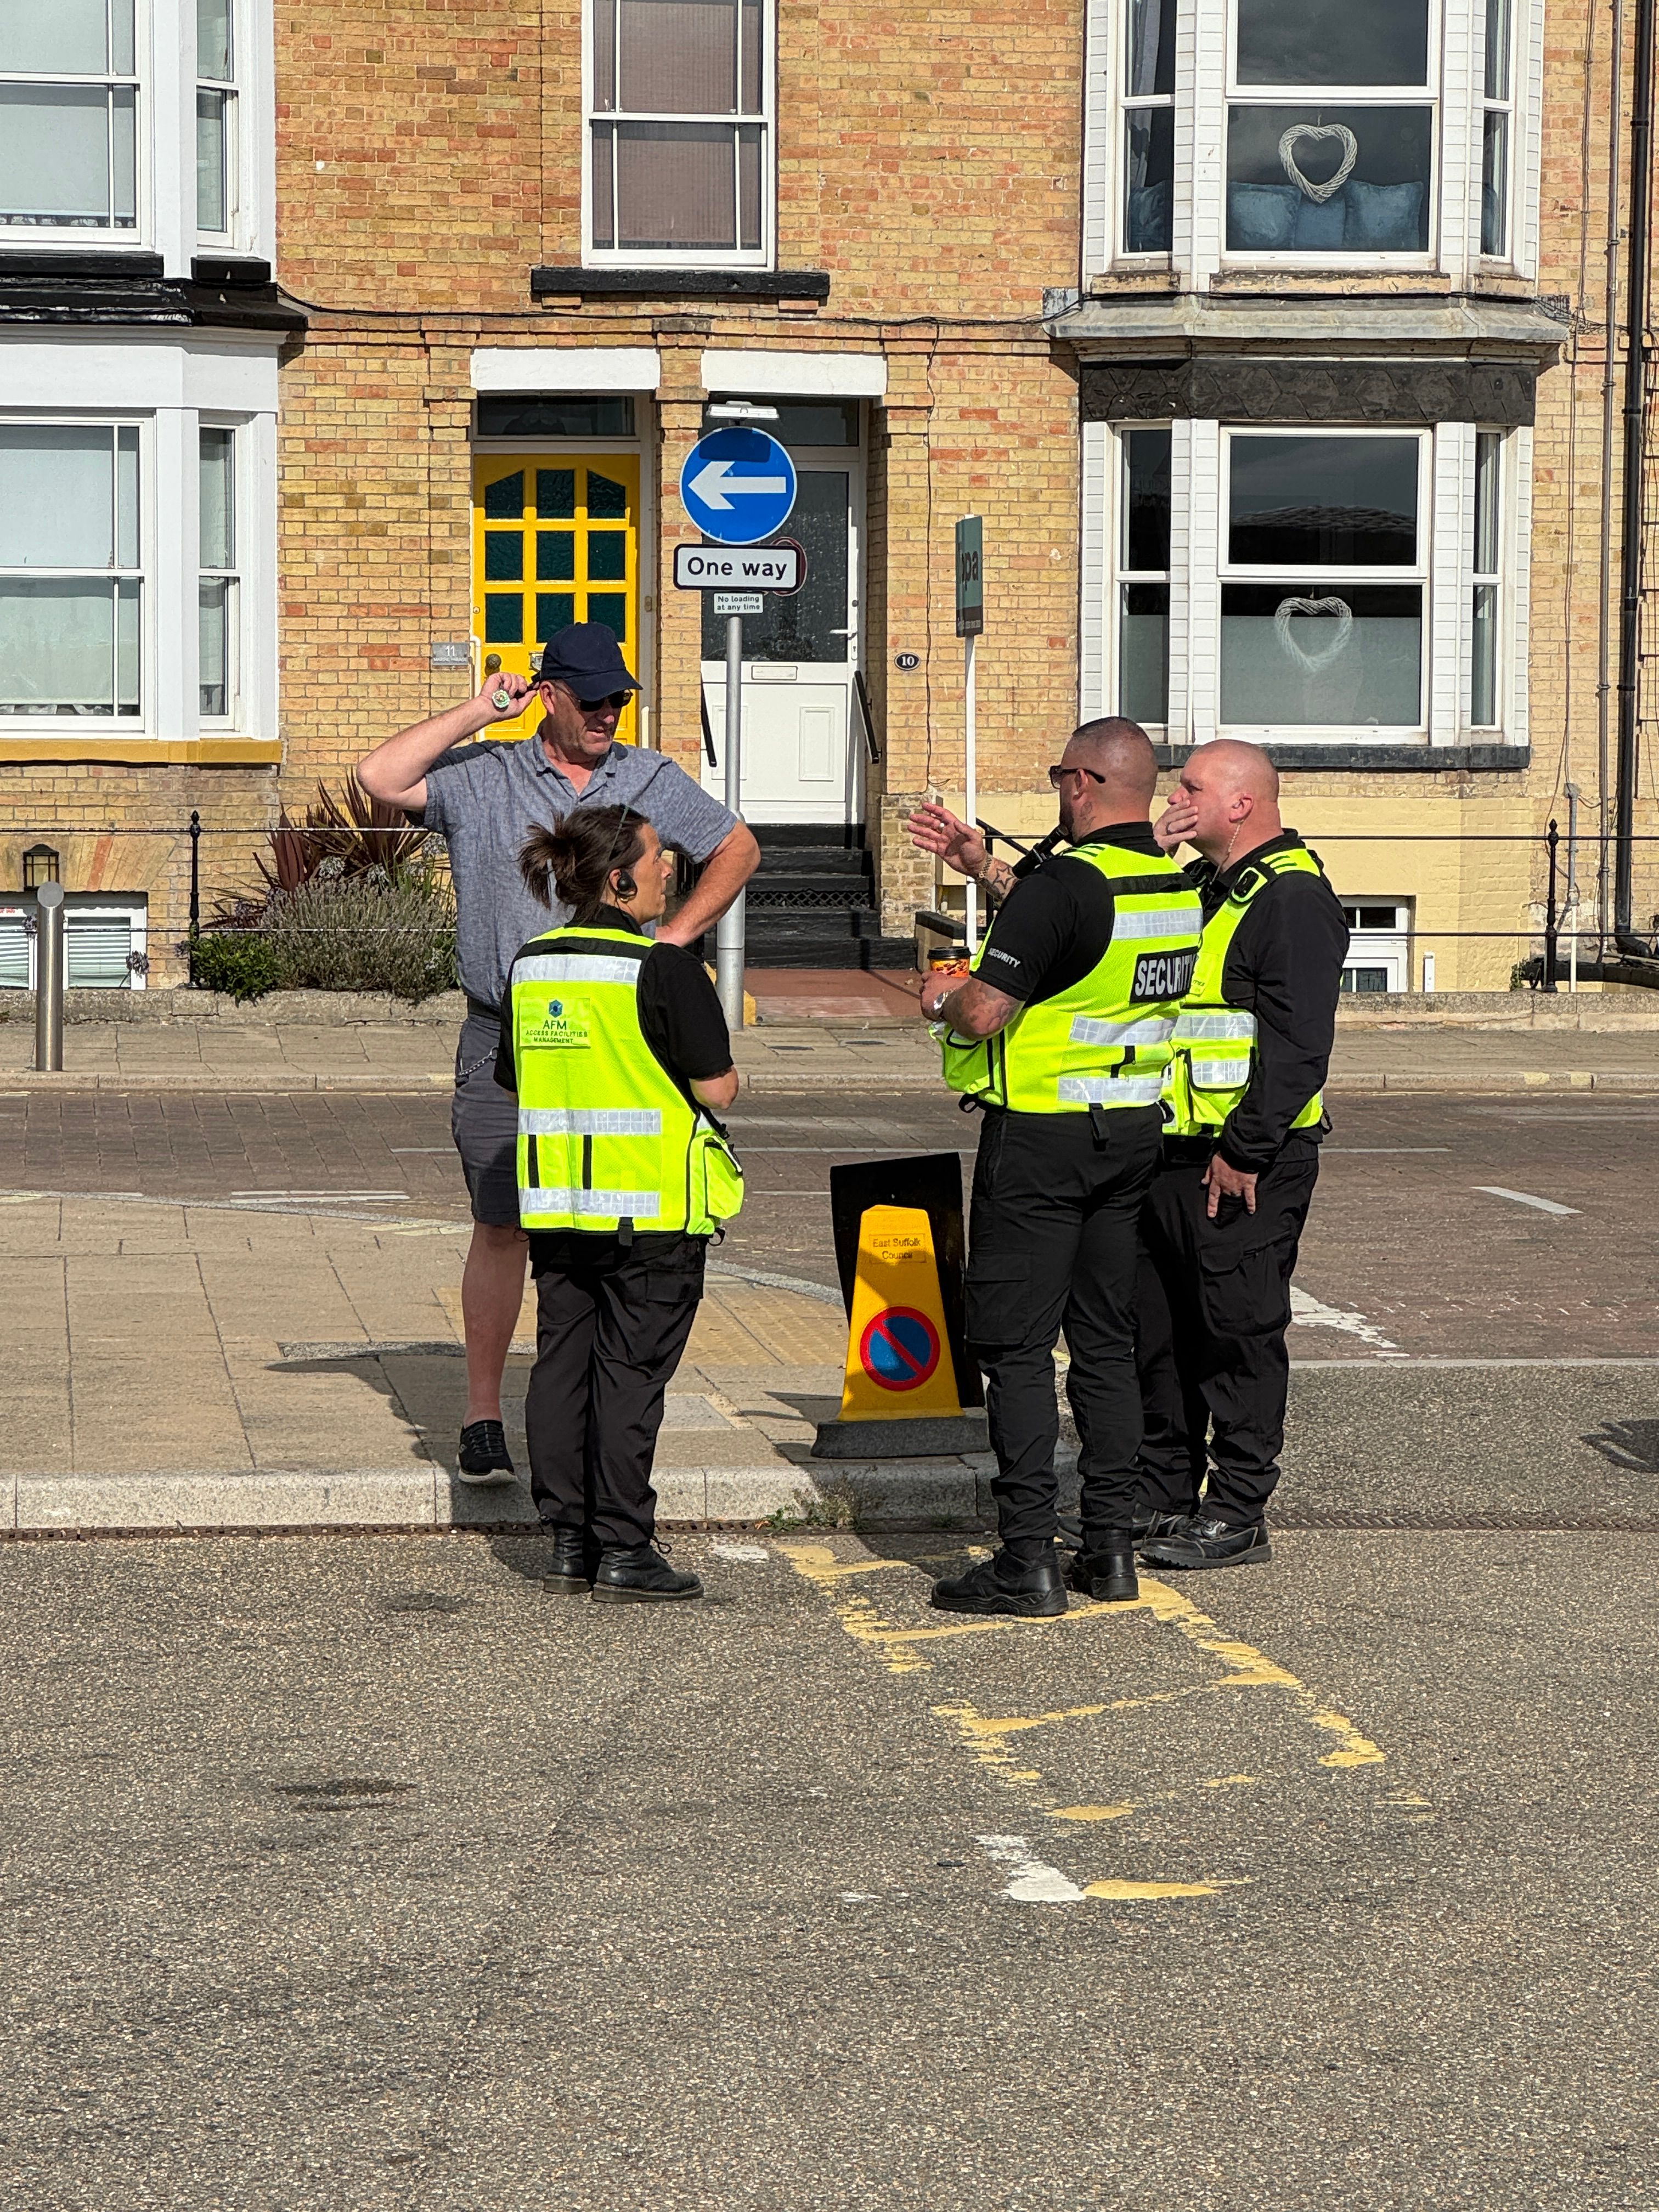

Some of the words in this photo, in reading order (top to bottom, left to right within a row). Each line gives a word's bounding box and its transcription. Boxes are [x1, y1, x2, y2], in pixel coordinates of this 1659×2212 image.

[687, 556, 733, 575] One
[742, 562, 787, 580] way
[445, 645, 455, 657] 11
[901, 656, 915, 666] 10
[988, 947, 1020, 968] SECURITY
[1135, 953, 1196, 996] SECURITY
[543, 1019, 567, 1030] AFM
[873, 1238, 890, 1248] East
[893, 1238, 921, 1247] Suffolk
